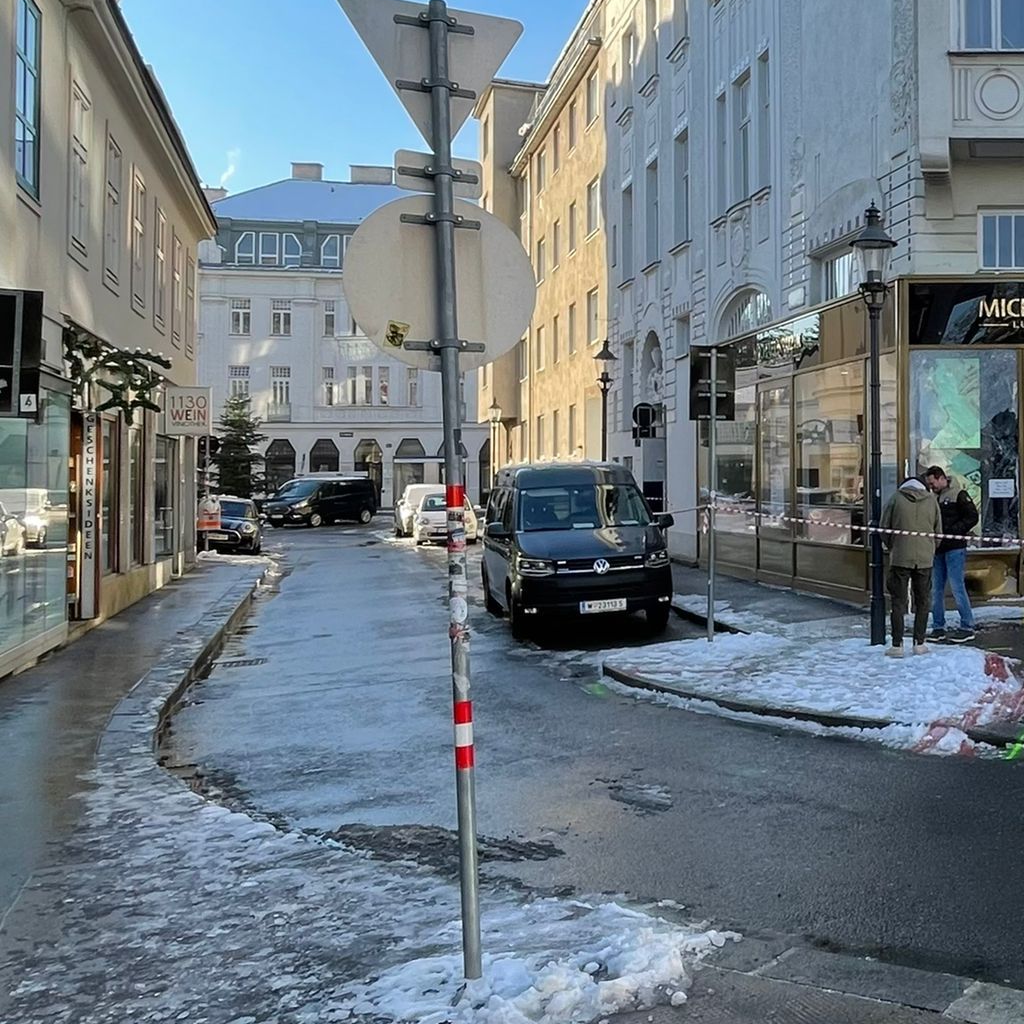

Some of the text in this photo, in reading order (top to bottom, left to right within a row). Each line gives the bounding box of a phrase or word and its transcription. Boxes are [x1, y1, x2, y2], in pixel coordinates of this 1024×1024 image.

[171, 396, 207, 409] 1130
[171, 409, 207, 421] WEIN
[84, 414, 95, 560] GESCHENKSIDEEN
